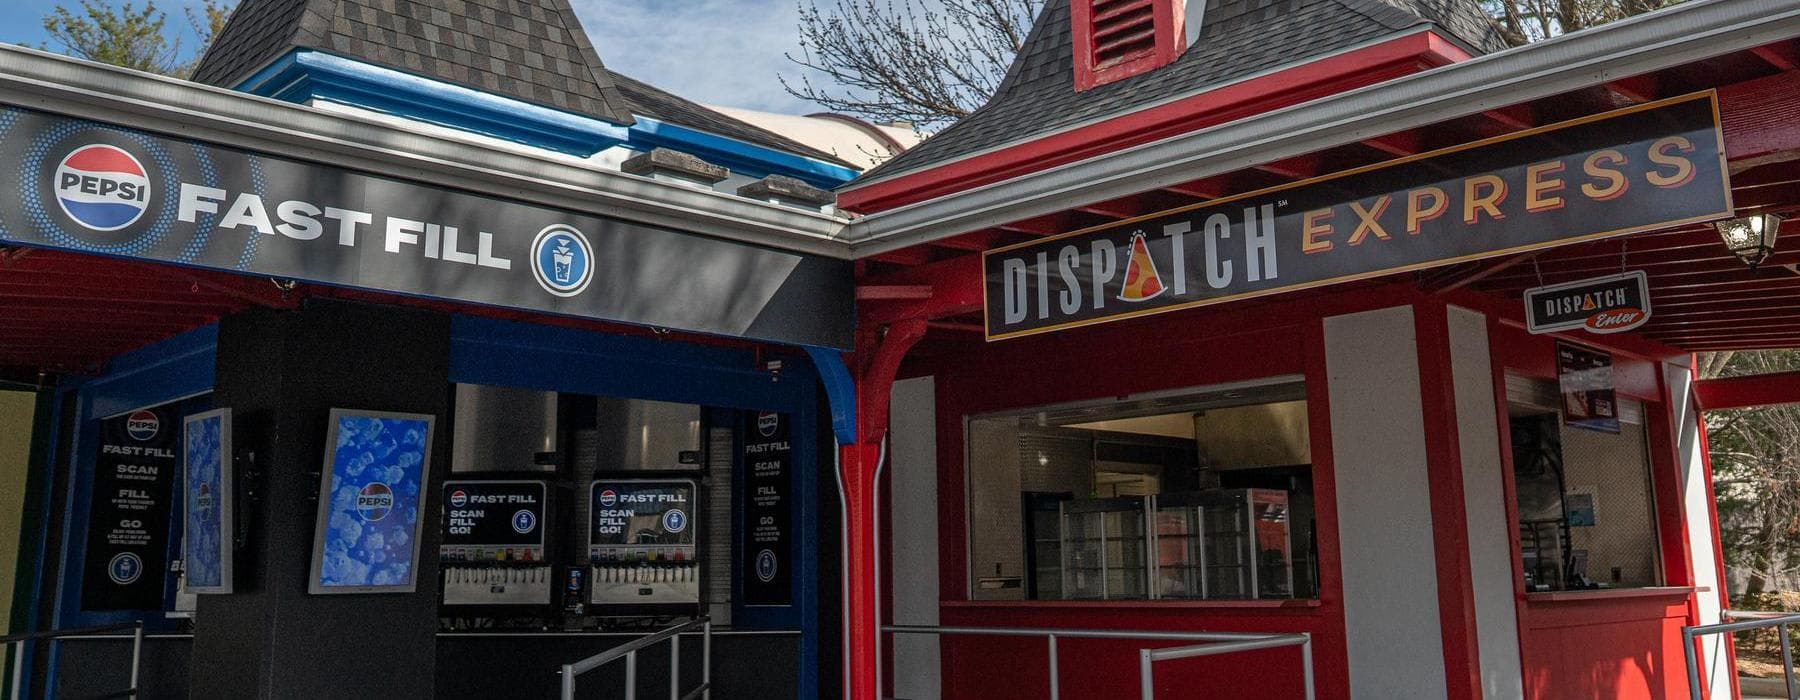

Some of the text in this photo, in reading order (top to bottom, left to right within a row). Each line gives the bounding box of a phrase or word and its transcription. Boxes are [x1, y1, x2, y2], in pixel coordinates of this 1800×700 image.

[61, 171, 145, 202] PEPSI
[177, 182, 511, 270] FAST FILL
[1004, 201, 1278, 325] DISPATCH
[1302, 135, 1696, 254] EXPRESS
[1545, 287, 1626, 317] DISPATCH
[1595, 311, 1639, 328] Enter
[760, 416, 777, 424] PEPSI
[129, 421, 157, 430] PEPSI
[103, 445, 175, 458] FAST FILL
[746, 441, 790, 454] FAST FILL
[116, 464, 158, 475] SCAN
[755, 460, 780, 471] SCAN
[119, 489, 150, 499] FILL
[757, 486, 776, 495] FILL
[358, 497, 391, 506] PEPSI
[470, 495, 536, 503] FAST FILL
[620, 494, 687, 503] FAST FILL
[450, 510, 485, 518] SCAN
[600, 509, 635, 517] SCAN
[120, 519, 142, 528] GO
[600, 518, 626, 526] FILL
[760, 516, 774, 525] GO
[449, 527, 471, 535] GO!
[600, 526, 621, 534] GO!
